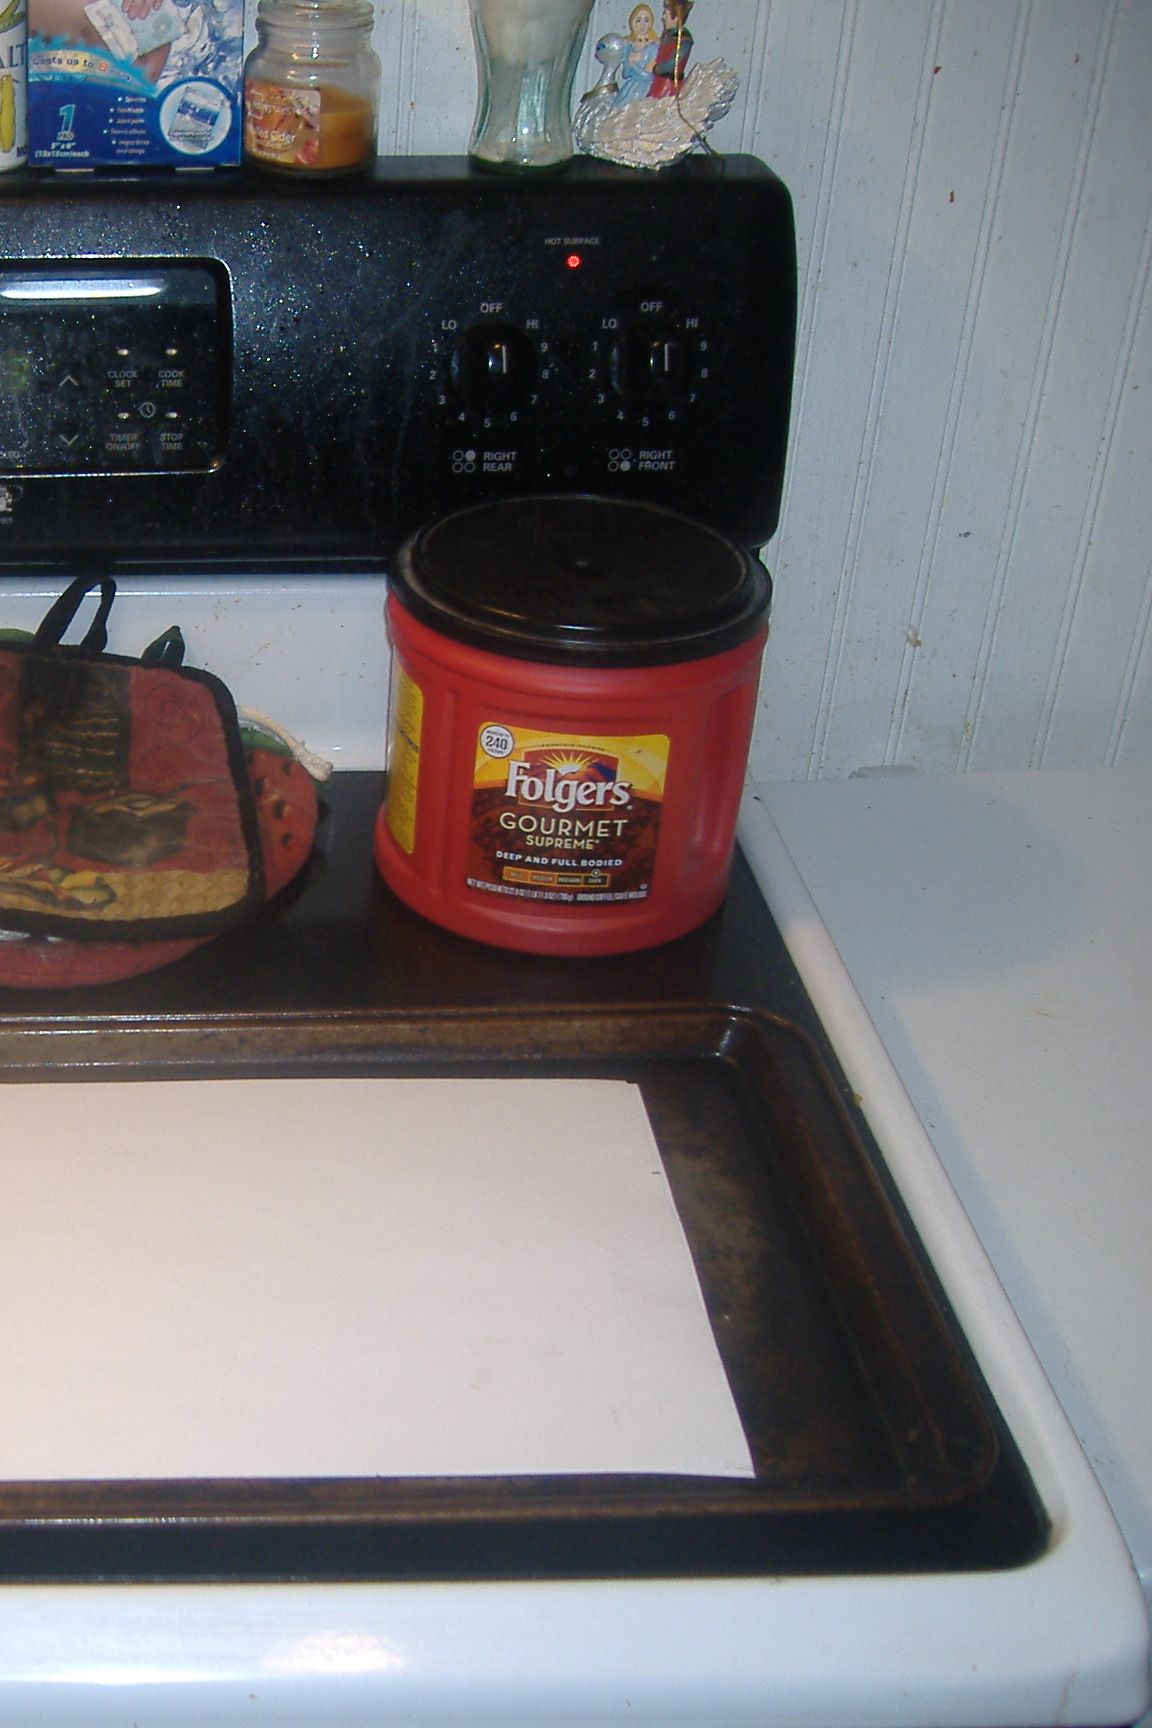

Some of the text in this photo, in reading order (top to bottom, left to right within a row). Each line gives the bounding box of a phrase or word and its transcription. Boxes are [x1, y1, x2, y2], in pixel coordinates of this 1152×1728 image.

[59, 104, 76, 132] 1
[544, 237, 600, 246] HOT SURFACE
[480, 303, 503, 314] OFF
[640, 302, 663, 313] OFF
[442, 319, 457, 330] LO
[526, 319, 539, 329] HI
[602, 318, 617, 329] LO
[686, 318, 698, 328] HI
[432, 343, 438, 352] 1
[540, 342, 548, 352] 9
[592, 342, 598, 351] 1
[700, 341, 707, 351] 9
[107, 370, 138, 378] CLOCK
[158, 370, 184, 378] COOK
[429, 370, 436, 380] 2
[542, 369, 549, 379] 8
[588, 369, 596, 379] 2
[701, 368, 708, 378] 8
[438, 395, 446, 405] 3
[531, 395, 538, 404] 7
[598, 394, 605, 403] 3
[689, 394, 696, 403] 7
[458, 412, 465, 421] 4
[510, 412, 517, 421] 6
[617, 411, 624, 420] 4
[668, 410, 676, 420] 6
[484, 418, 491, 428] 5
[642, 417, 649, 427] 5
[159, 432, 184, 442] STOP
[162, 442, 183, 451] TIME
[483, 452, 517, 462] RIGHT
[639, 450, 672, 460] RIGHT
[483, 462, 512, 472] REAR
[638, 461, 675, 471] FRONT
[486, 734, 508, 751] 240
[505, 759, 632, 814] Folgers
[499, 811, 629, 838] GOURMET
[525, 834, 595, 850] SUPREME
[496, 850, 624, 868] DEEP AND FULL BODIED
